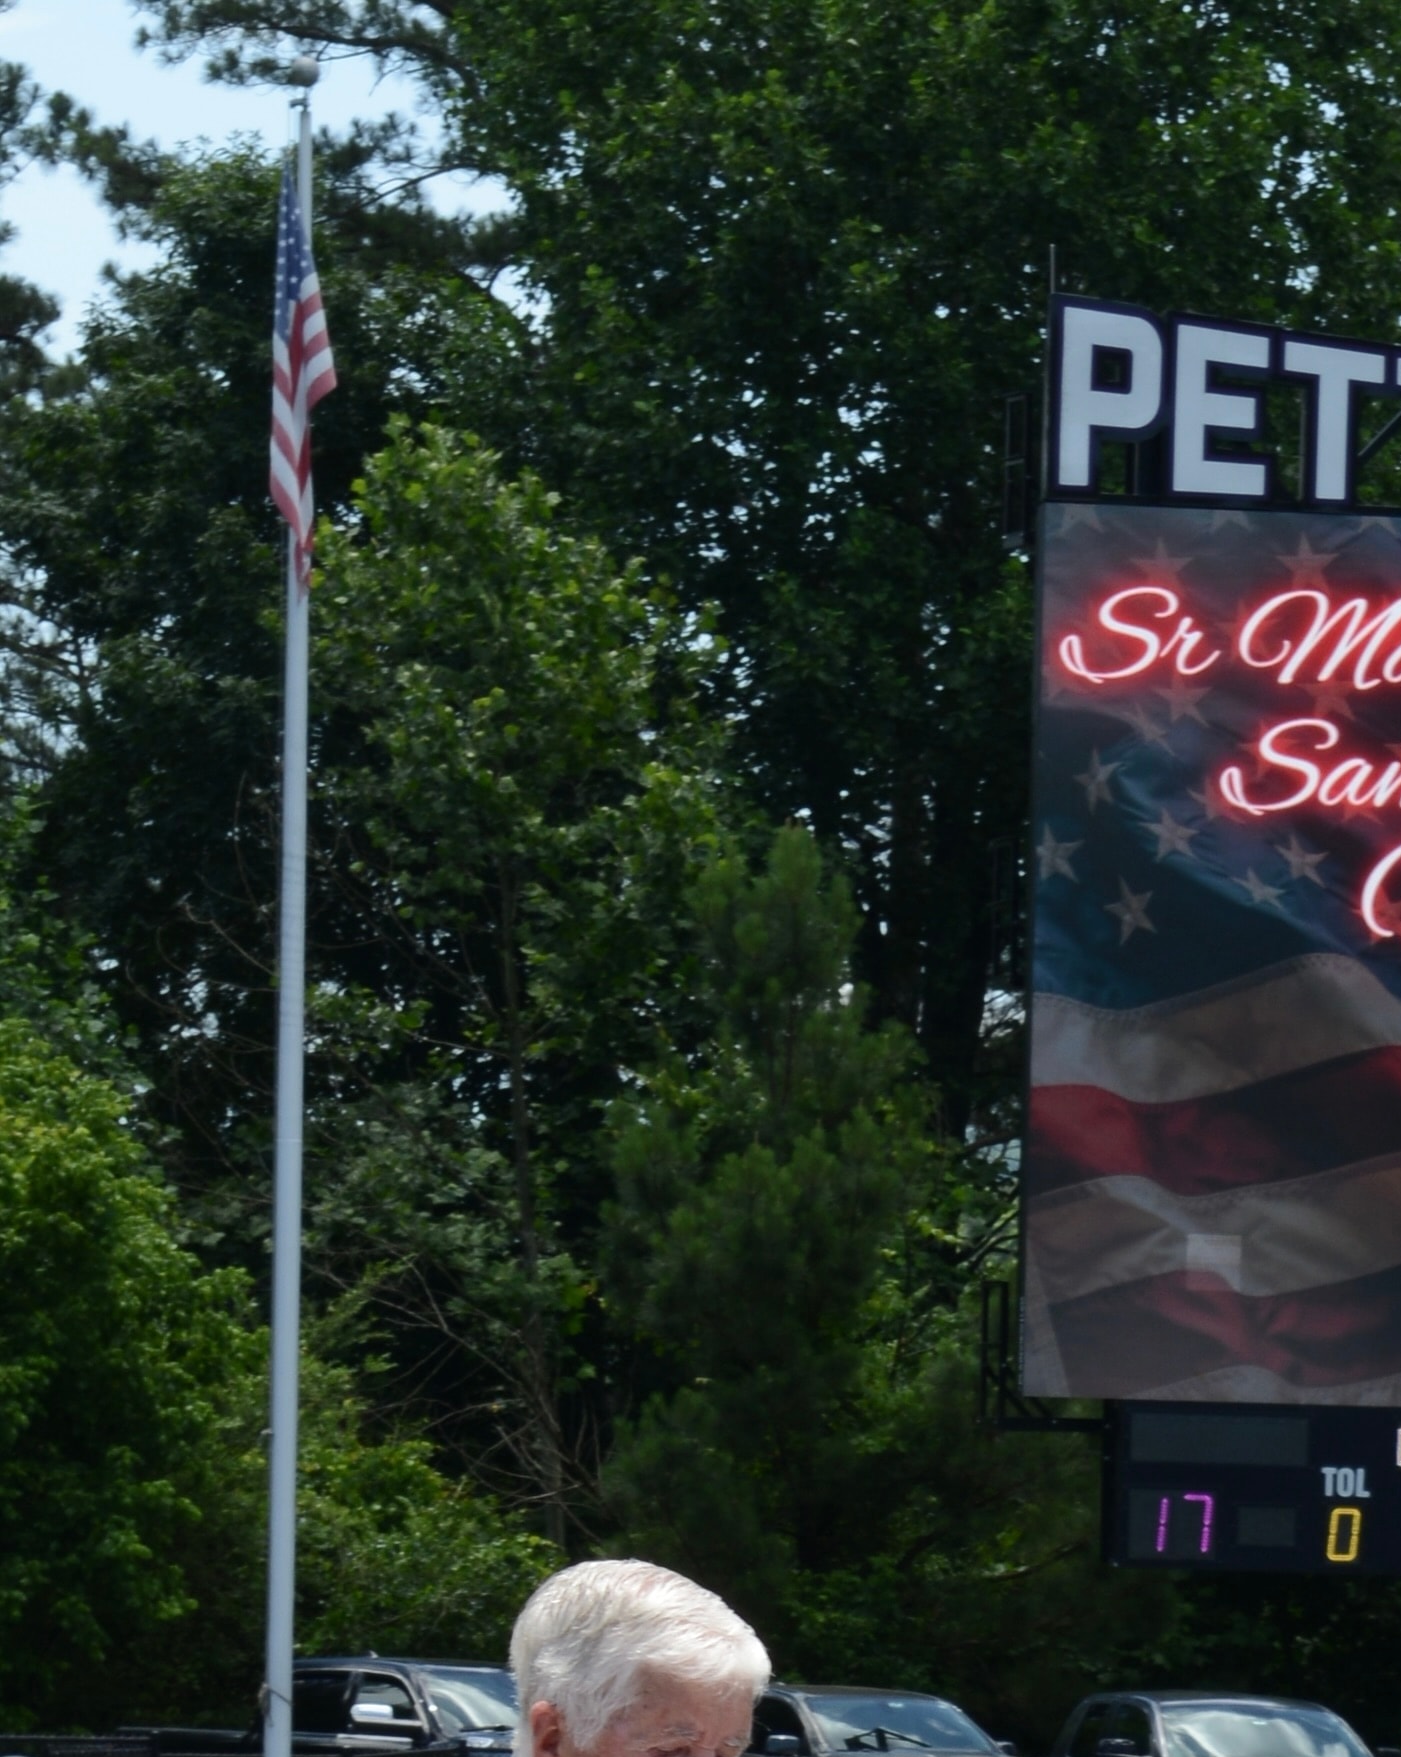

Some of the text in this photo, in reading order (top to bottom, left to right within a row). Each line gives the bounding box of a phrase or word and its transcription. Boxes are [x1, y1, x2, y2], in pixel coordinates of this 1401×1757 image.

[1059, 585, 1220, 684] Sr
[1321, 1466, 1371, 1498] TOL
[1154, 1493, 1214, 1553] 17
[1326, 1507, 1362, 1563] 0
